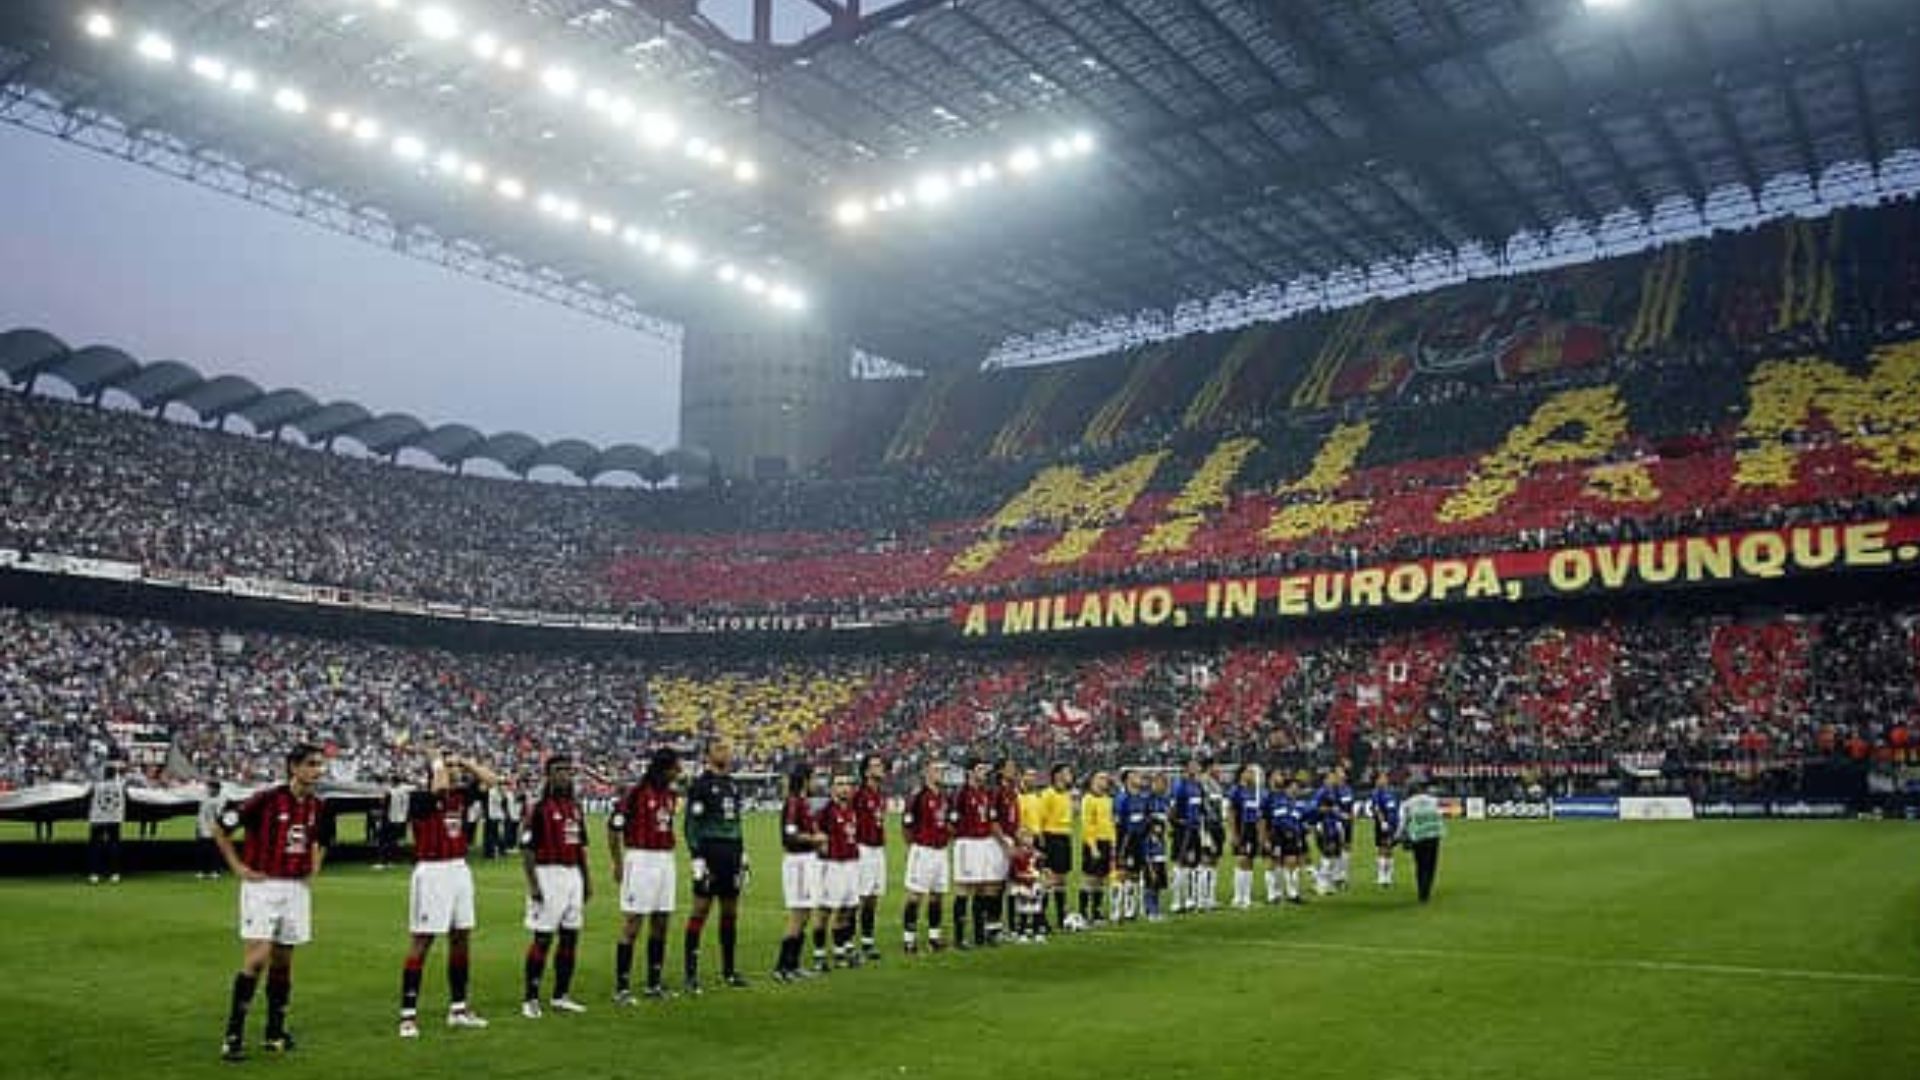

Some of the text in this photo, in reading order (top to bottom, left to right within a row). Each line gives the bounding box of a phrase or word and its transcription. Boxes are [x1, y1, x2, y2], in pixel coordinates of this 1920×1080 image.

[962, 521, 1919, 637] A MILANO, IN EUROPA, OVUNQUE.
